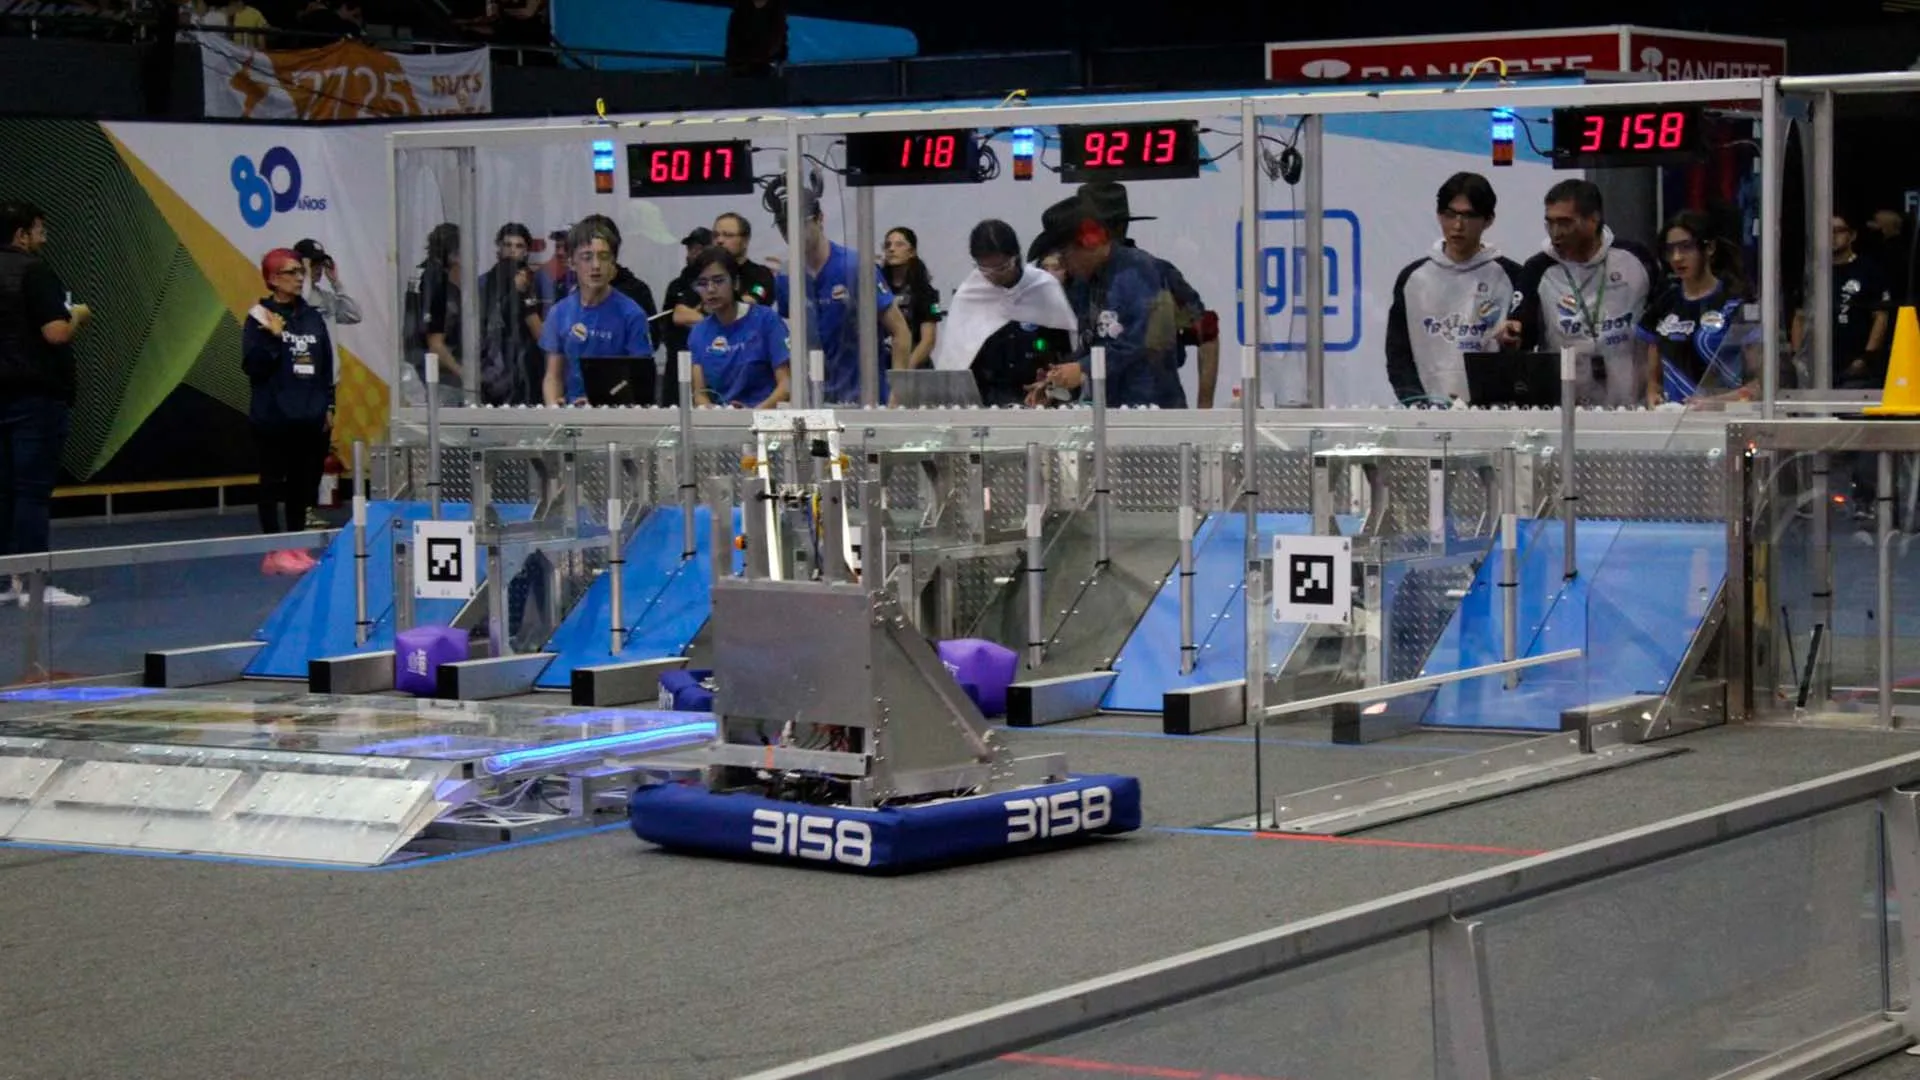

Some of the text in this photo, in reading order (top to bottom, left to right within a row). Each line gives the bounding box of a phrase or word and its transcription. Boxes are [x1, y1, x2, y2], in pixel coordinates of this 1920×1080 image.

[1085, 129, 1176, 166] 9213
[1581, 112, 1684, 151] 3158
[650, 148, 732, 182] 6017
[901, 135, 955, 169] 118
[230, 146, 302, 229] 80
[1004, 785, 1113, 843] 3158
[751, 808, 872, 867] 3158
